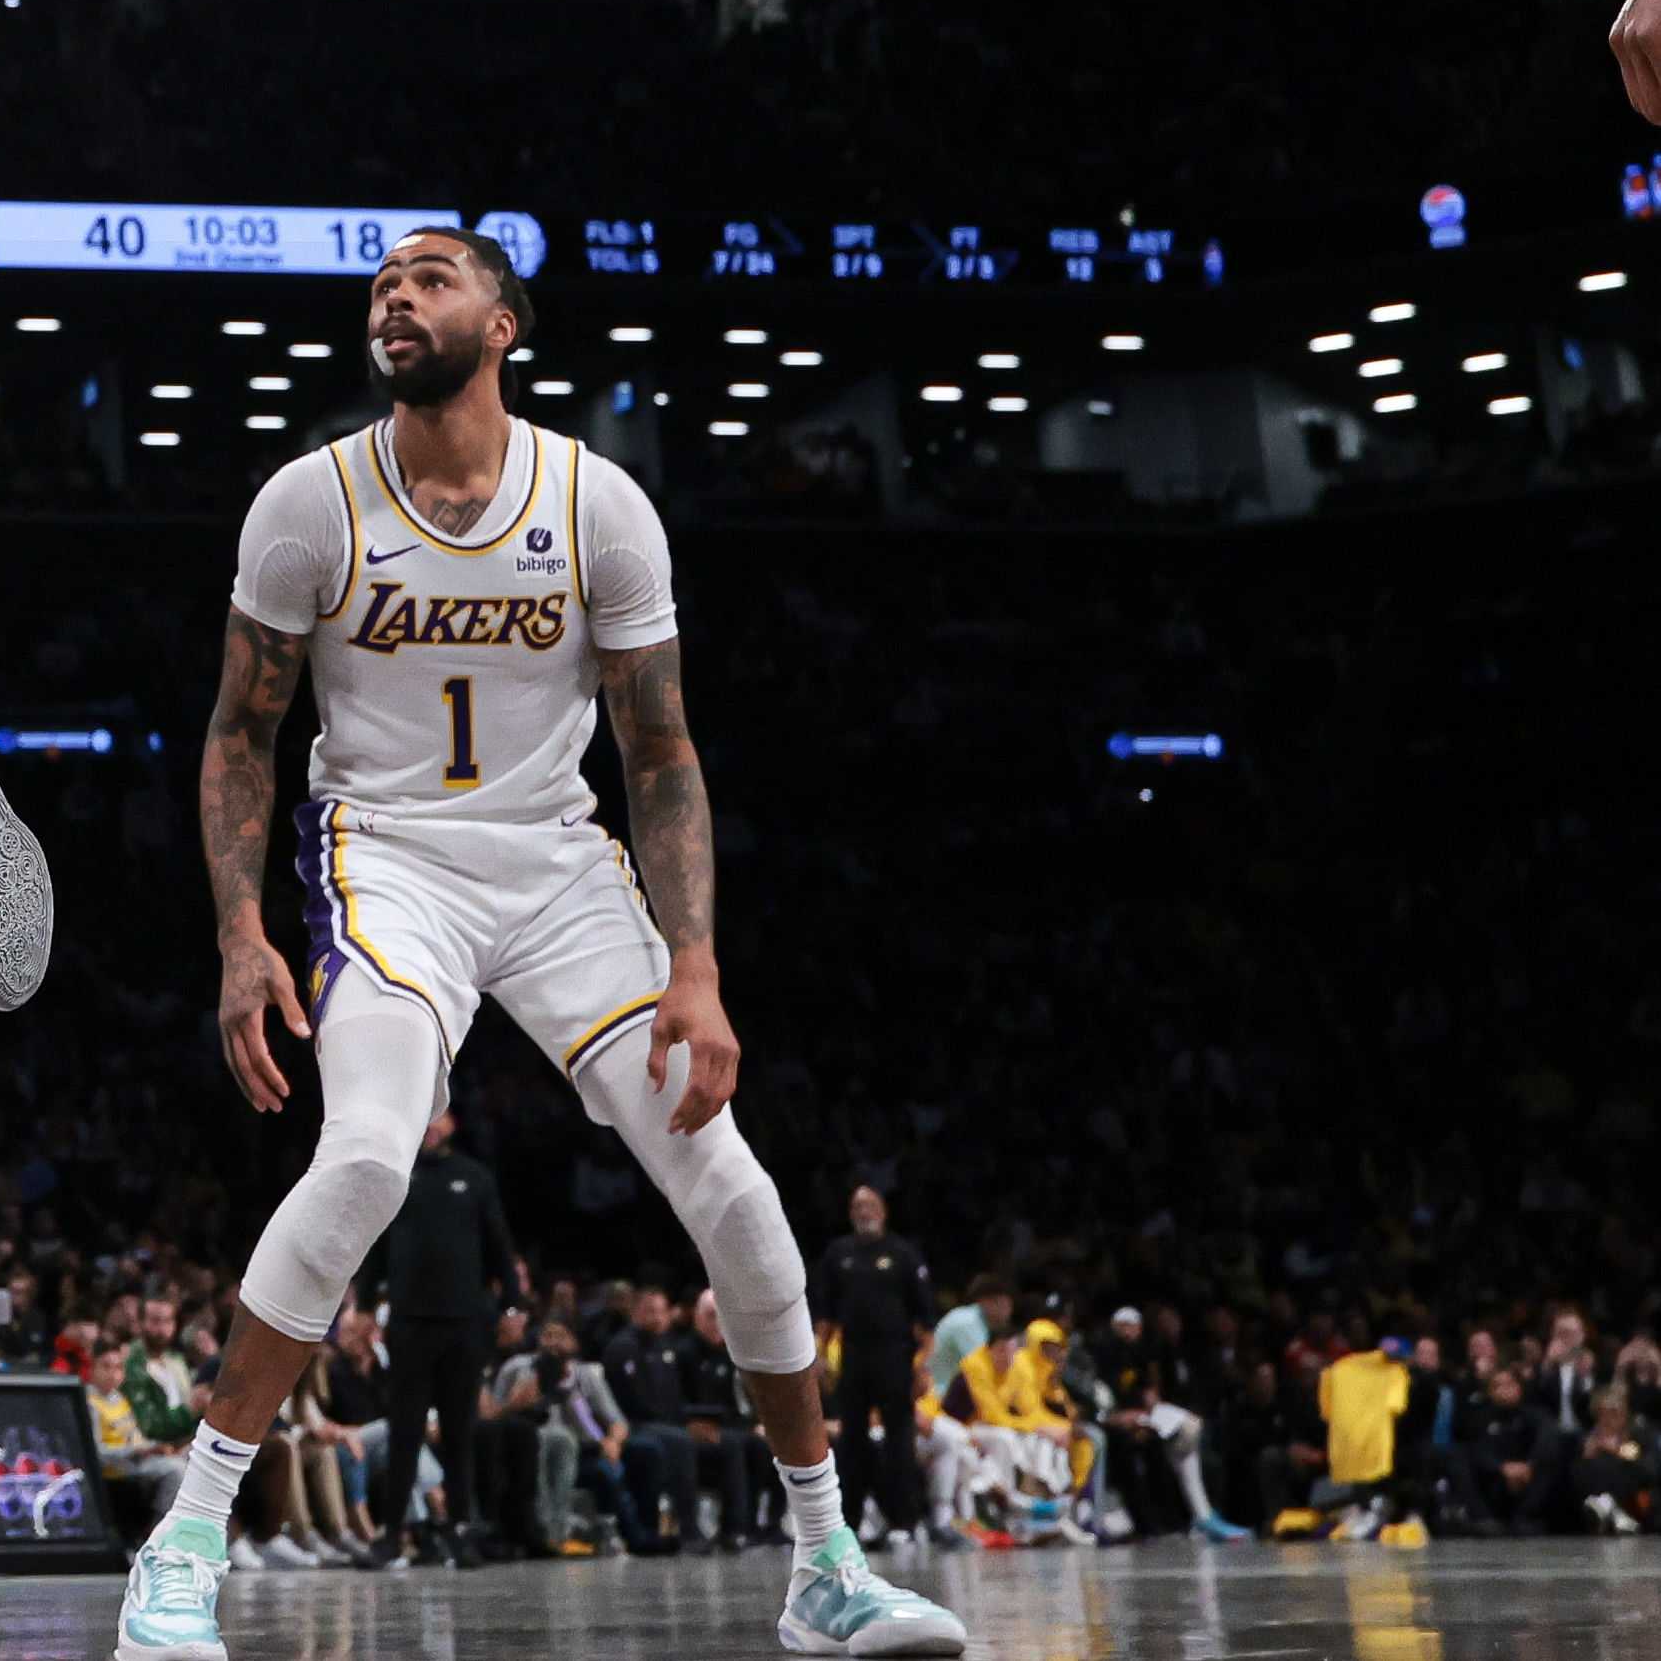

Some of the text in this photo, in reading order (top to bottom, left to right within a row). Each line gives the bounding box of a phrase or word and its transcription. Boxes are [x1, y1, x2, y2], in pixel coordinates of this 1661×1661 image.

[83, 215, 384, 262] 40 10:03 18
[516, 556, 567, 576] bibigo
[346, 580, 573, 657] LAKERS
[441, 675, 482, 789] 1
